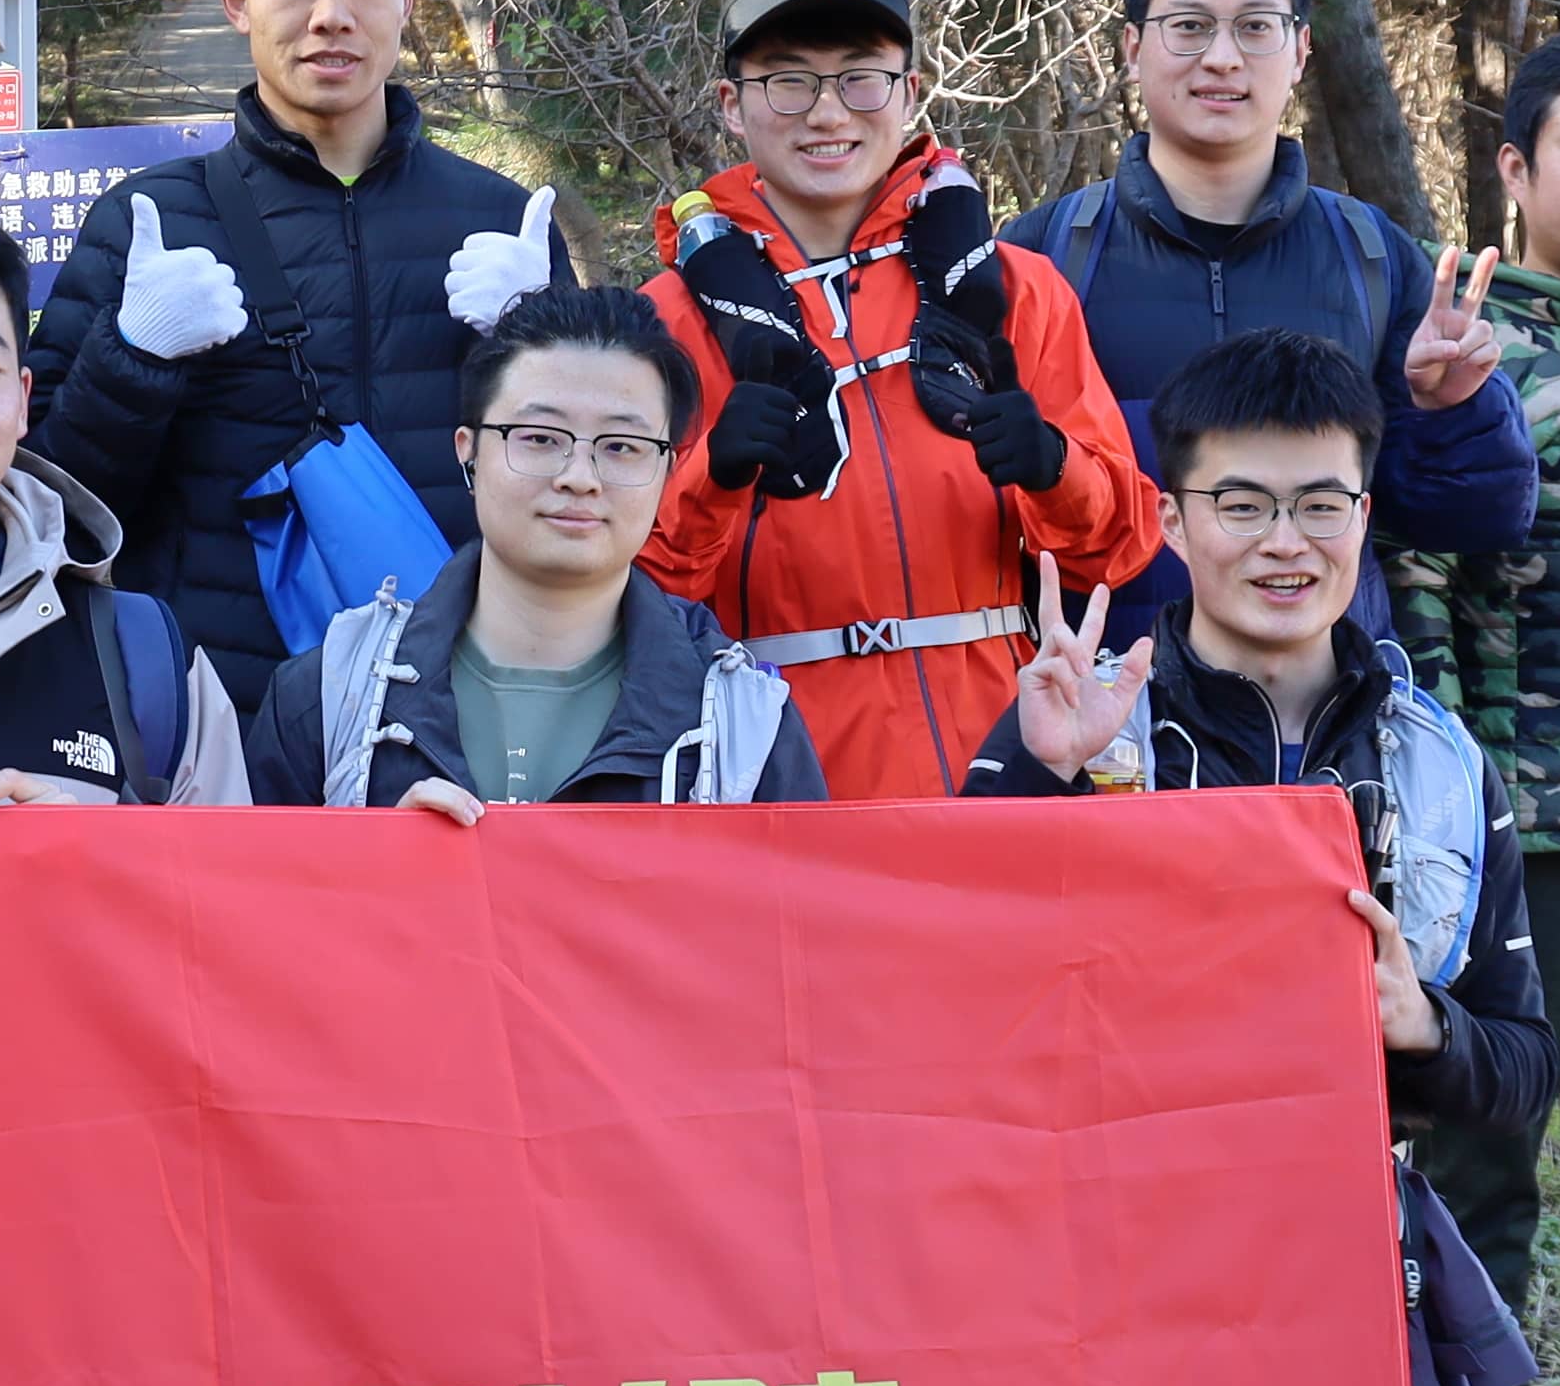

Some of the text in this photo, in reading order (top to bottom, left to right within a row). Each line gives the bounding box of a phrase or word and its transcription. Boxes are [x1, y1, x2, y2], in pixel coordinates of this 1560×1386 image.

[76, 730, 99, 747] THE
[52, 739, 99, 759] NORTH
[66, 753, 98, 771] FACE
